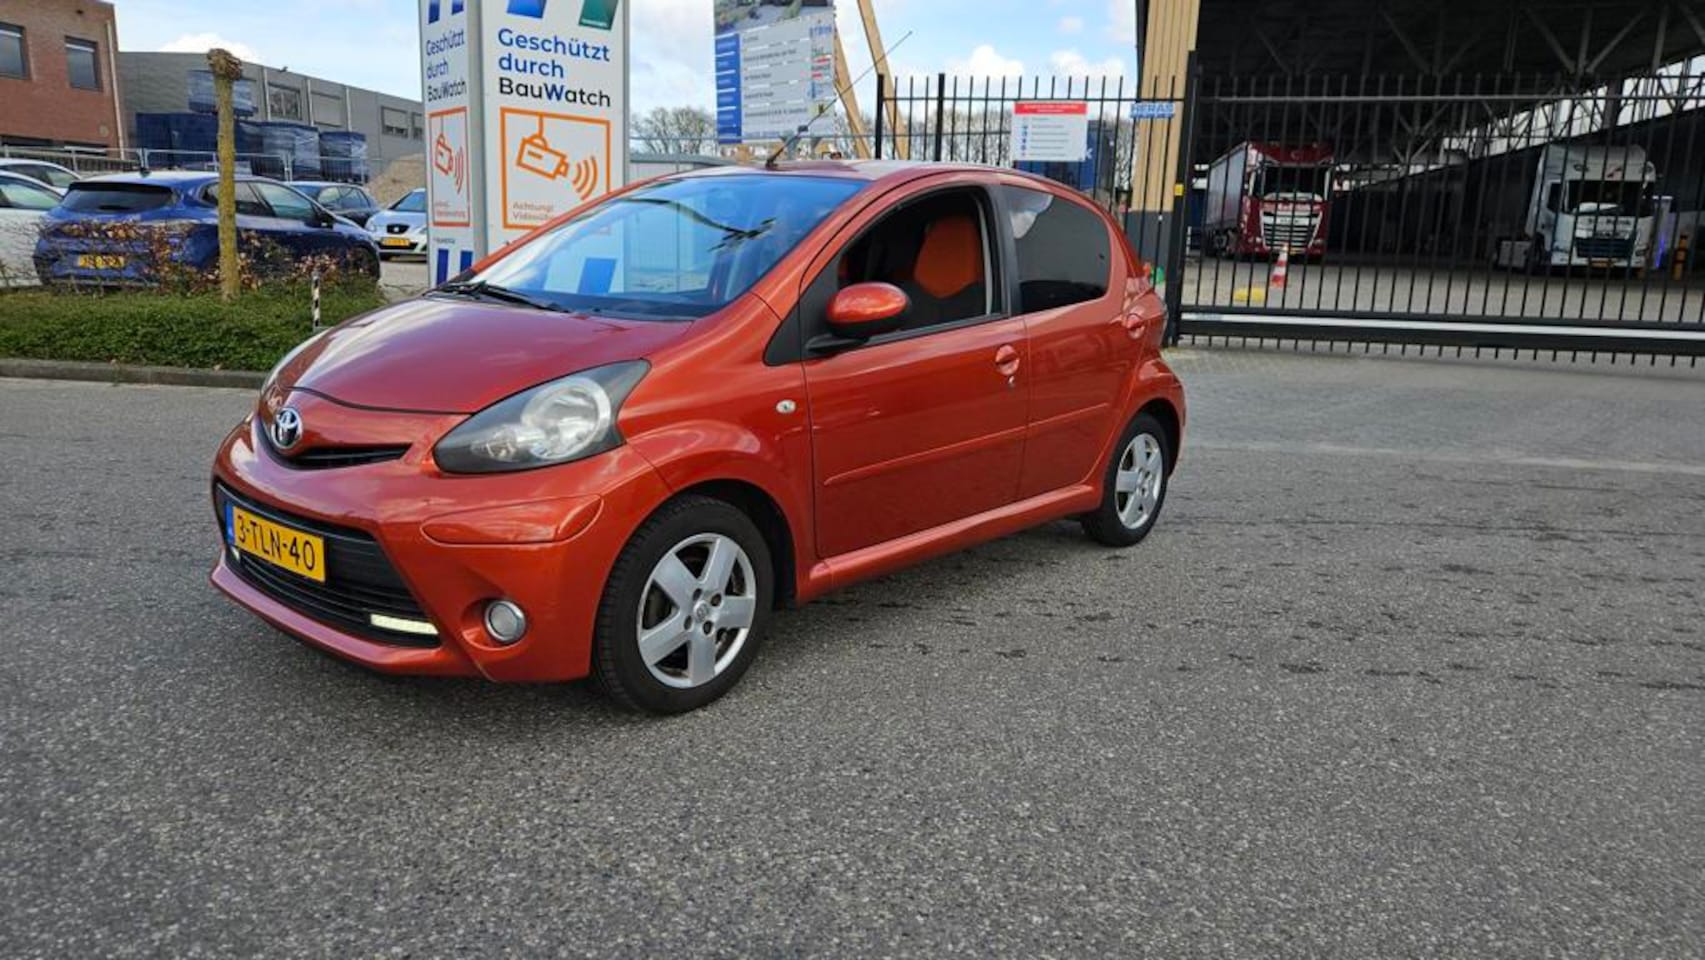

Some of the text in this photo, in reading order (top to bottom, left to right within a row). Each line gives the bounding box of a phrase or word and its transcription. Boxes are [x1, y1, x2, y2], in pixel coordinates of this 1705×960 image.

[426, 30, 465, 56] Geschützt
[498, 28, 610, 62] Geschützt
[426, 58, 448, 79] durch
[498, 52, 564, 78] durch
[427, 78, 467, 102] BauWatch
[499, 77, 611, 107] BauWatch
[237, 514, 316, 571] 3-TLN-40
